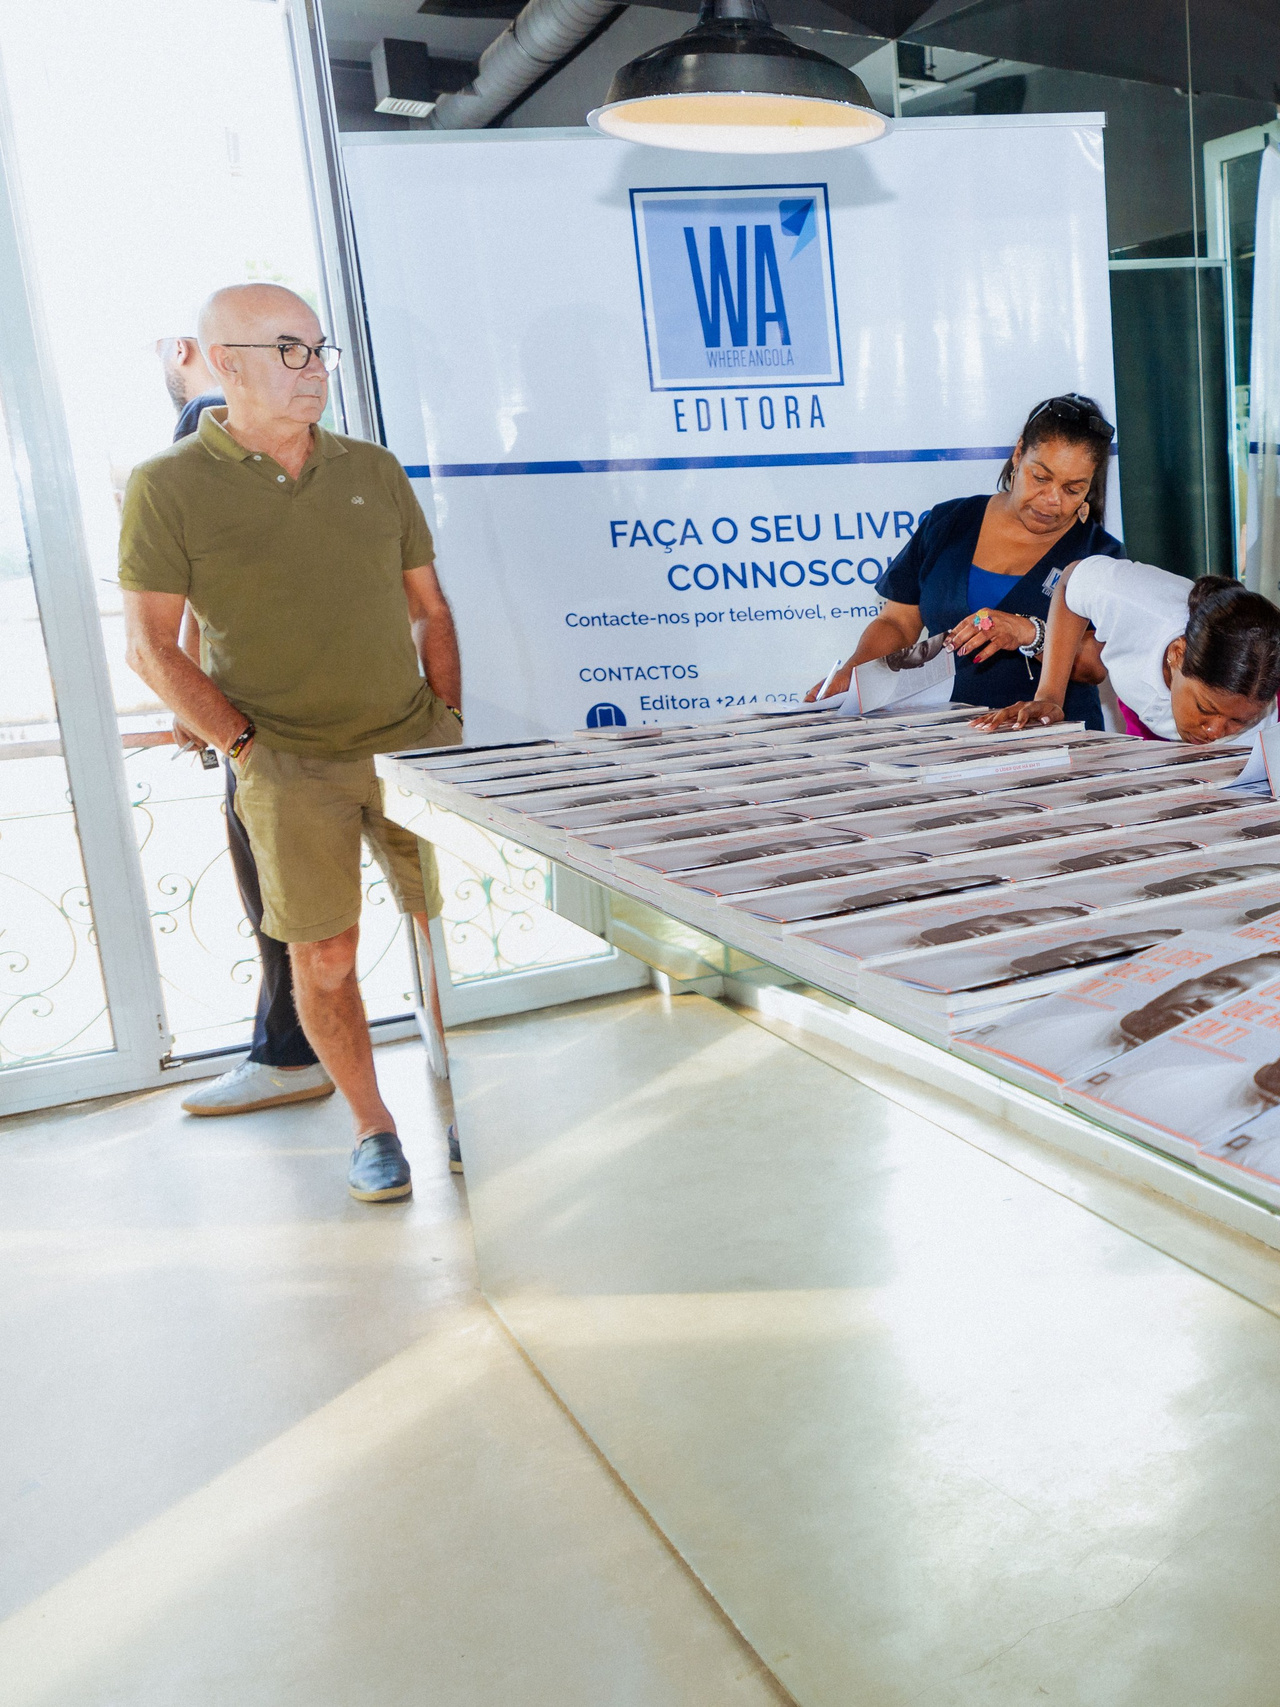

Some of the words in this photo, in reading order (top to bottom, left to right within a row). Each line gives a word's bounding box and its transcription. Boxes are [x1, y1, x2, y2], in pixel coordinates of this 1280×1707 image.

[683, 224, 791, 348] WA
[706, 349, 795, 369] WHEREANGOLA
[673, 394, 825, 432] EDITORA
[610, 518, 703, 553] FAÇA
[712, 517, 738, 544] O
[750, 514, 821, 543] SEU
[565, 606, 690, 628] Contacte-nos
[695, 610, 725, 627] por
[730, 605, 827, 624] telemóvel,
[579, 664, 699, 682] CONTACTOS
[640, 694, 710, 711] Editora
[1221, 1000, 1276, 1022] QUE
[1182, 1018, 1230, 1040] EM
[1213, 1026, 1251, 1047] TI
